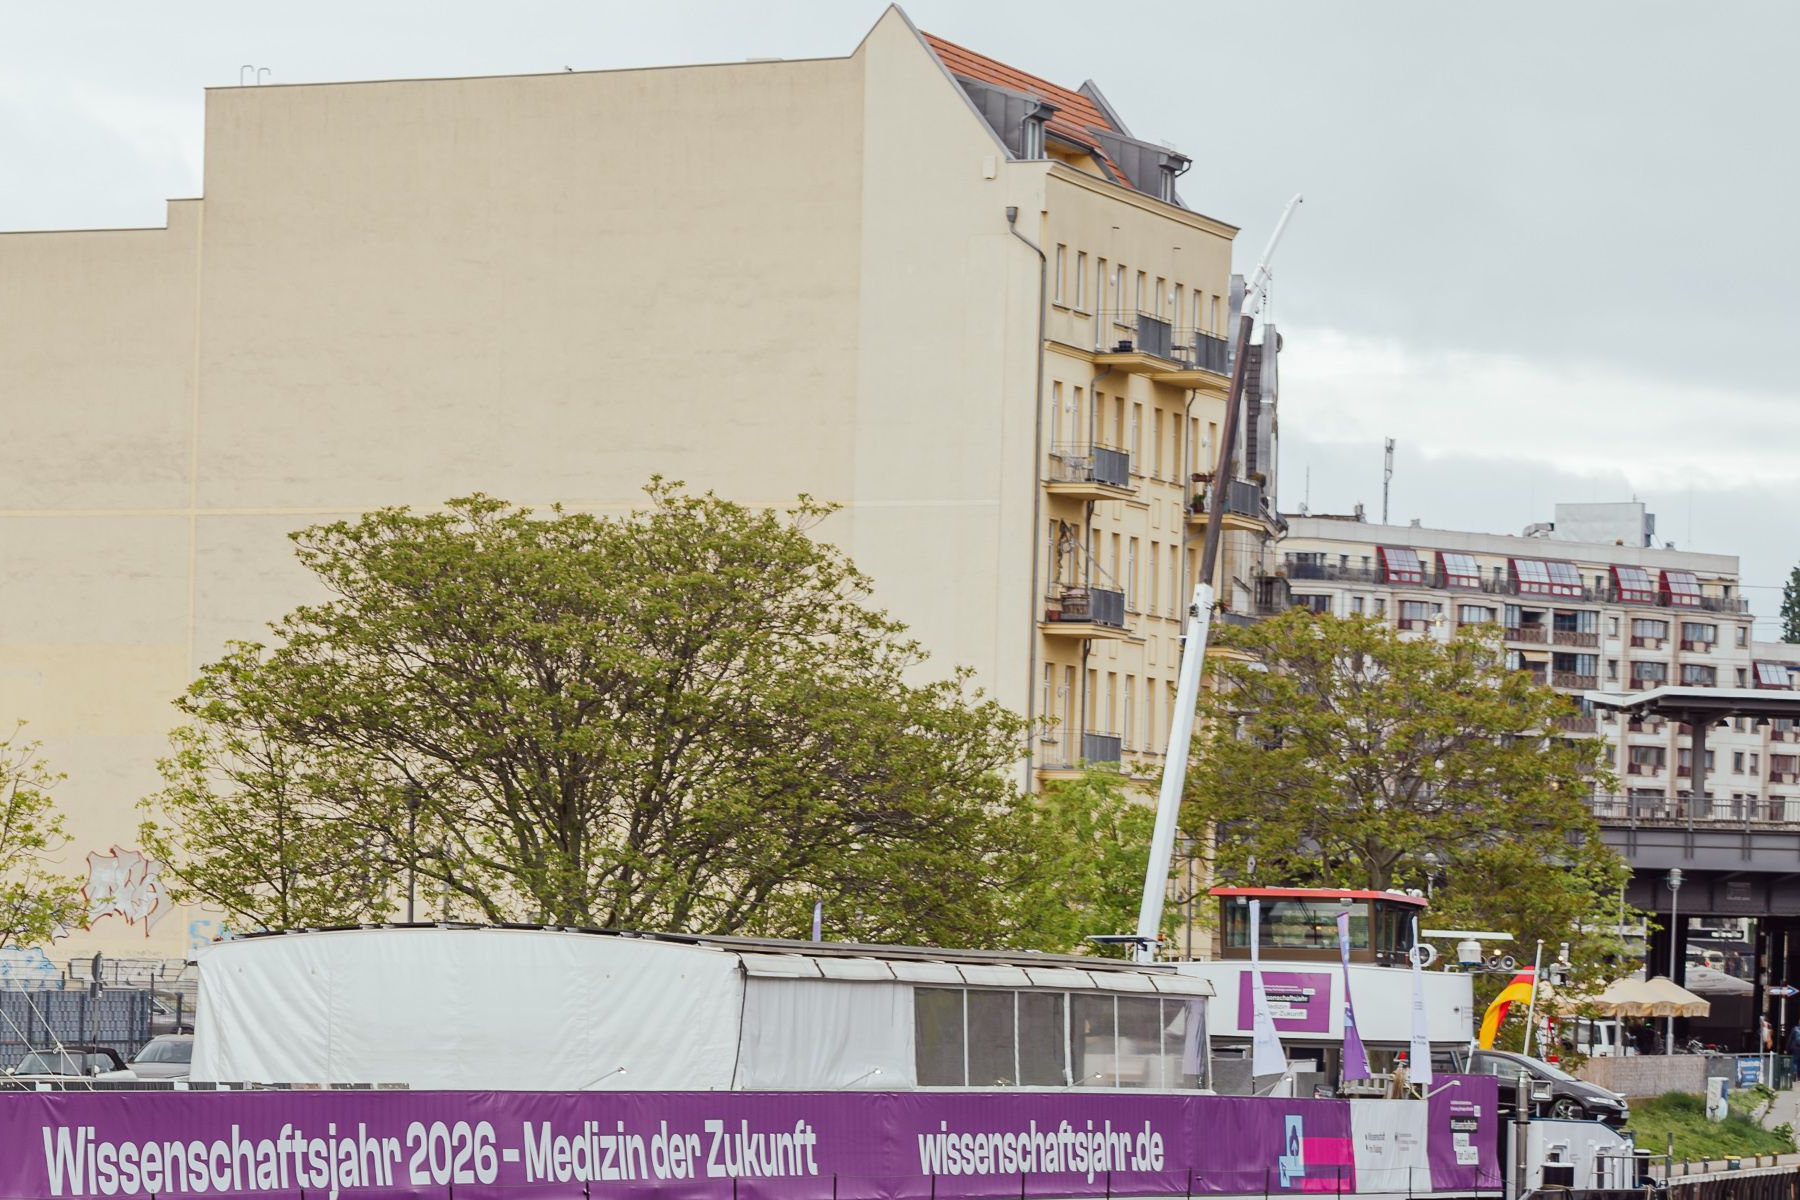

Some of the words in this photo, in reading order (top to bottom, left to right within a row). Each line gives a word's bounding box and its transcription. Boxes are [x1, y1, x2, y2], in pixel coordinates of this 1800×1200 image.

[406, 1120, 499, 1186] 2026
[523, 1120, 649, 1183] Medizin
[651, 1119, 701, 1180] der
[704, 1118, 819, 1178] Zukunft
[917, 1119, 1165, 1185] wissenschaftsjahr.de
